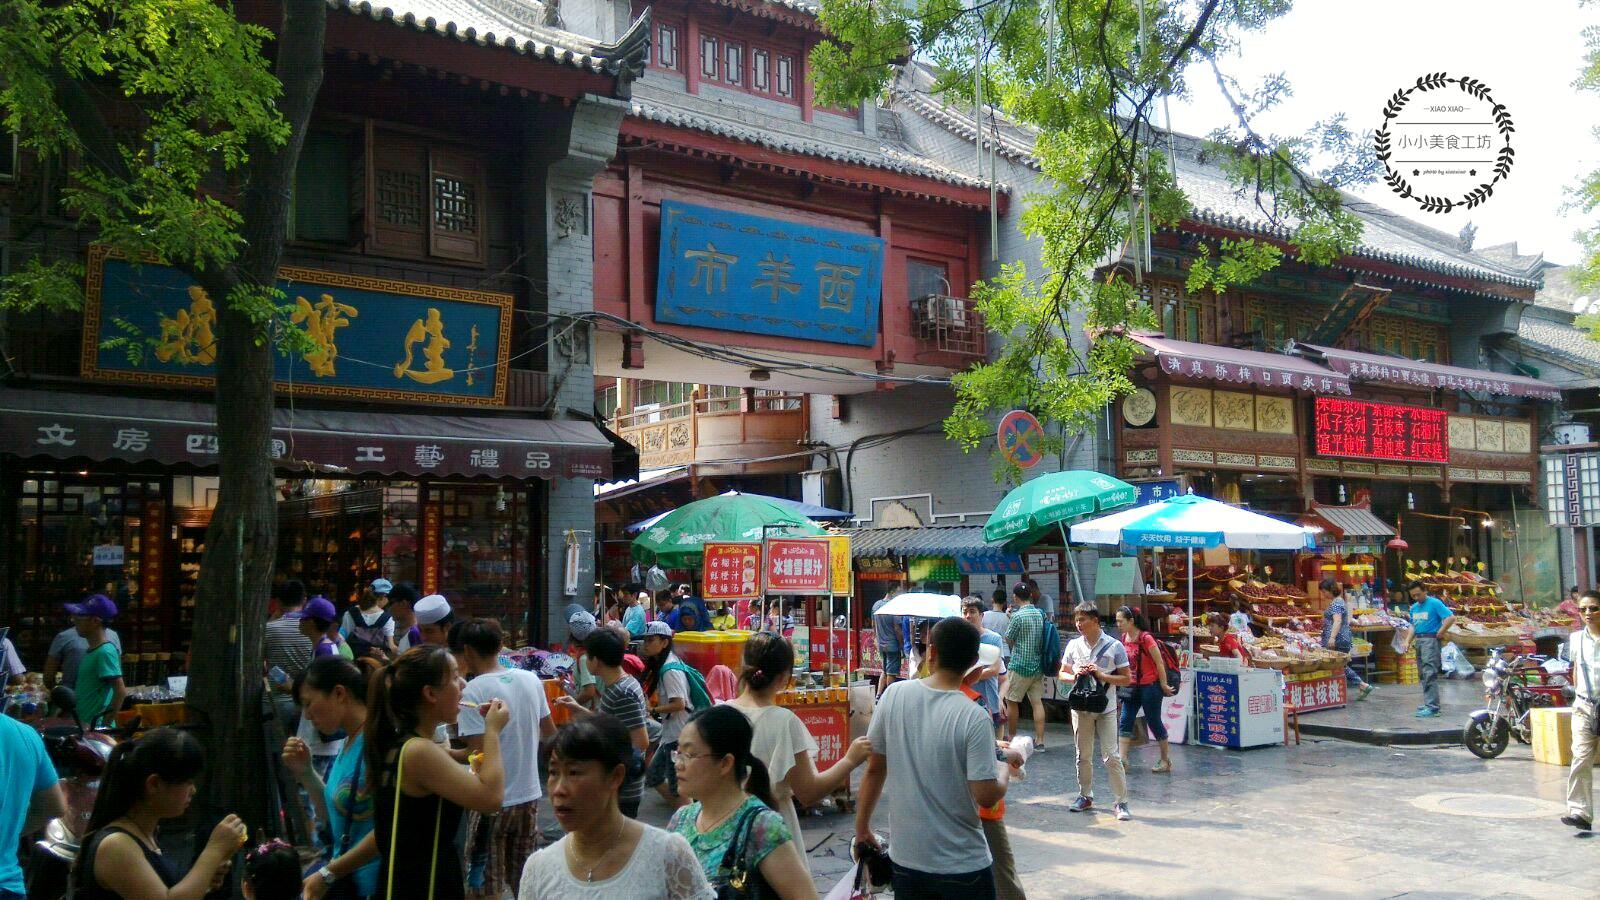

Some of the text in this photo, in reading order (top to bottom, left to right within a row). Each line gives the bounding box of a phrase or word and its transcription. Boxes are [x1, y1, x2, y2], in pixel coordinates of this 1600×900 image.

[1320, 413, 1366, 434] 瓜子系列
[1372, 418, 1405, 438] 无核枣
[773, 558, 823, 576] 冰糖雪梨汁
[1291, 679, 1341, 709] 椒盐核桃
